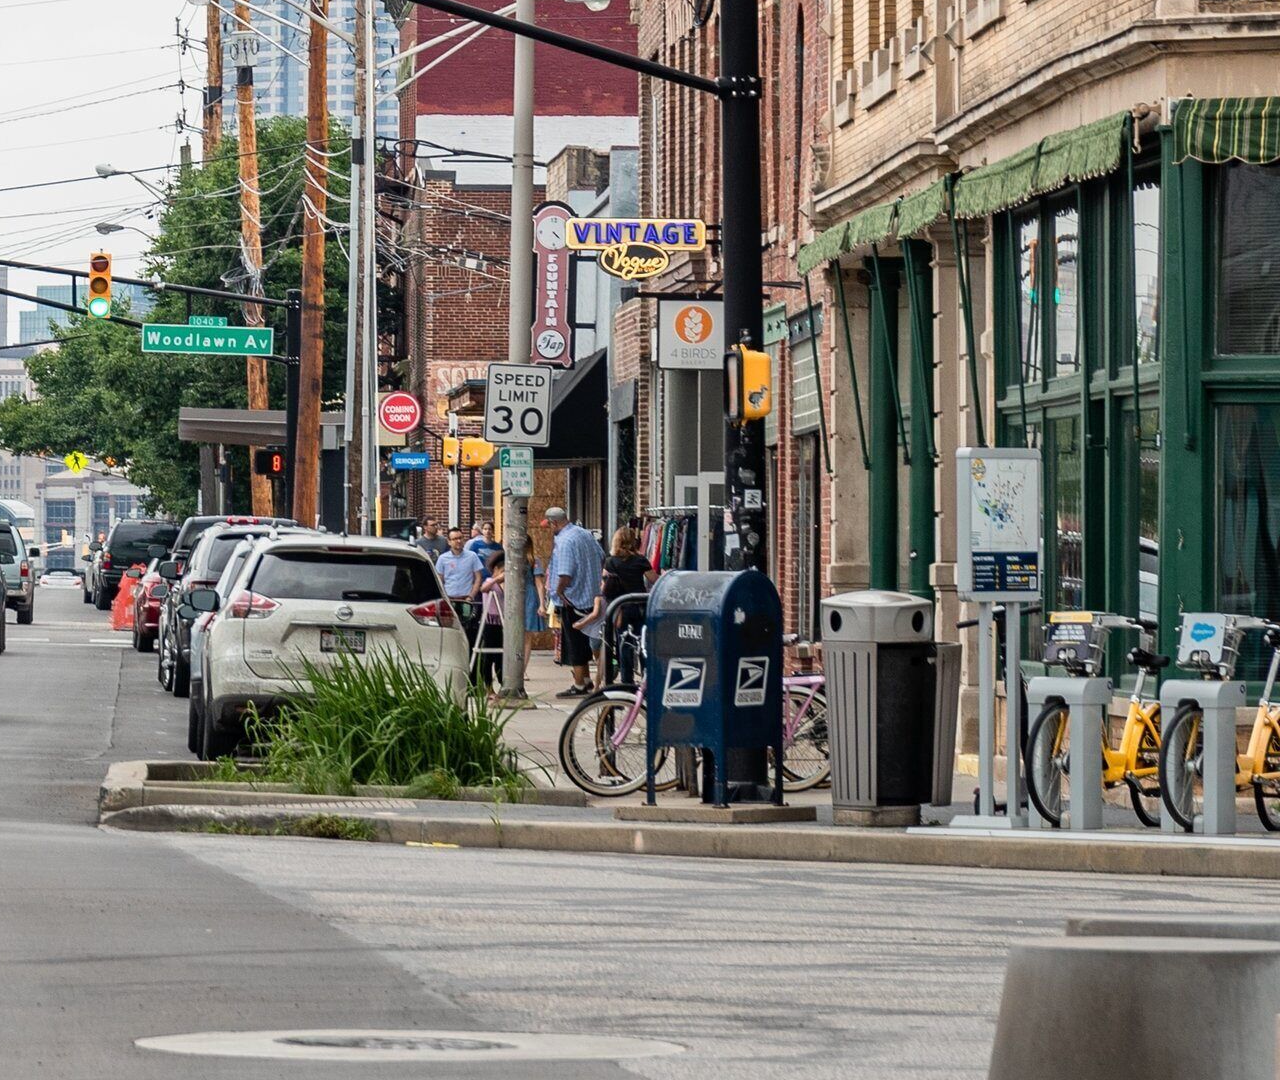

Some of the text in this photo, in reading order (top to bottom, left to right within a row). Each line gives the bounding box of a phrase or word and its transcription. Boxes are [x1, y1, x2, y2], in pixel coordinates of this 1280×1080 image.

[573, 222, 699, 245] VINTAGE
[607, 243, 666, 281] Vogue
[544, 253, 559, 327] FOUNTAIN
[192, 317, 224, 326] 1040 S
[147, 331, 268, 349] Woodlawn Av
[538, 333, 564, 354] Tap
[670, 348, 717, 360] 4 BIRDS
[494, 373, 545, 387] SPEED
[498, 390, 538, 403] LIMIT
[385, 405, 415, 414] COMING
[389, 414, 411, 423] SOON
[491, 405, 544, 436] 30
[394, 457, 426, 465] SERIOUSLY
[502, 454, 509, 466] 2
